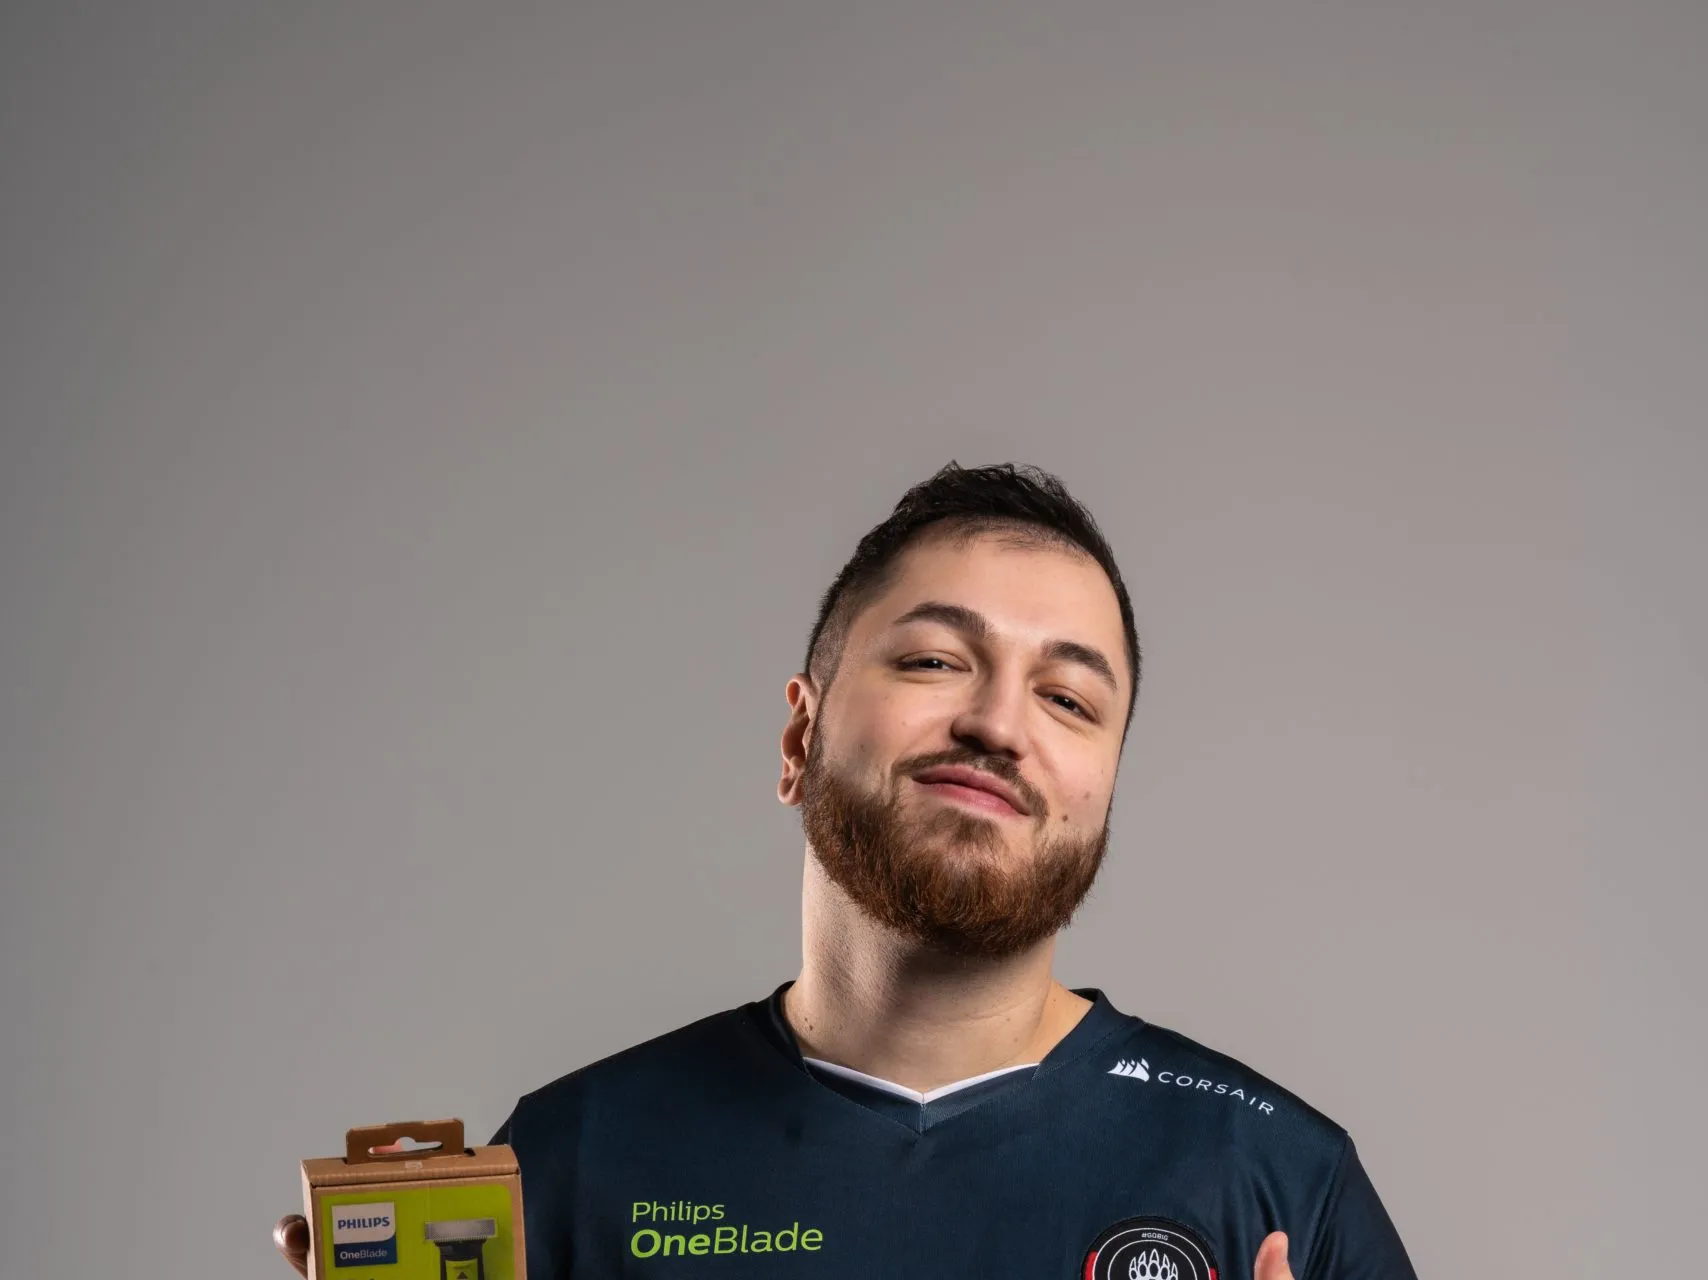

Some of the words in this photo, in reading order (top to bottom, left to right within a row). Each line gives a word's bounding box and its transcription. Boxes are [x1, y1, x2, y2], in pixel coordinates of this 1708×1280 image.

[1157, 1071, 1274, 1116] CORSAIR
[632, 1200, 725, 1225] Philips
[338, 1216, 390, 1230] PHILIPS
[630, 1221, 824, 1258] OneBlade
[1141, 1232, 1169, 1240] #GOBIG
[340, 1248, 388, 1260] OneBlade
